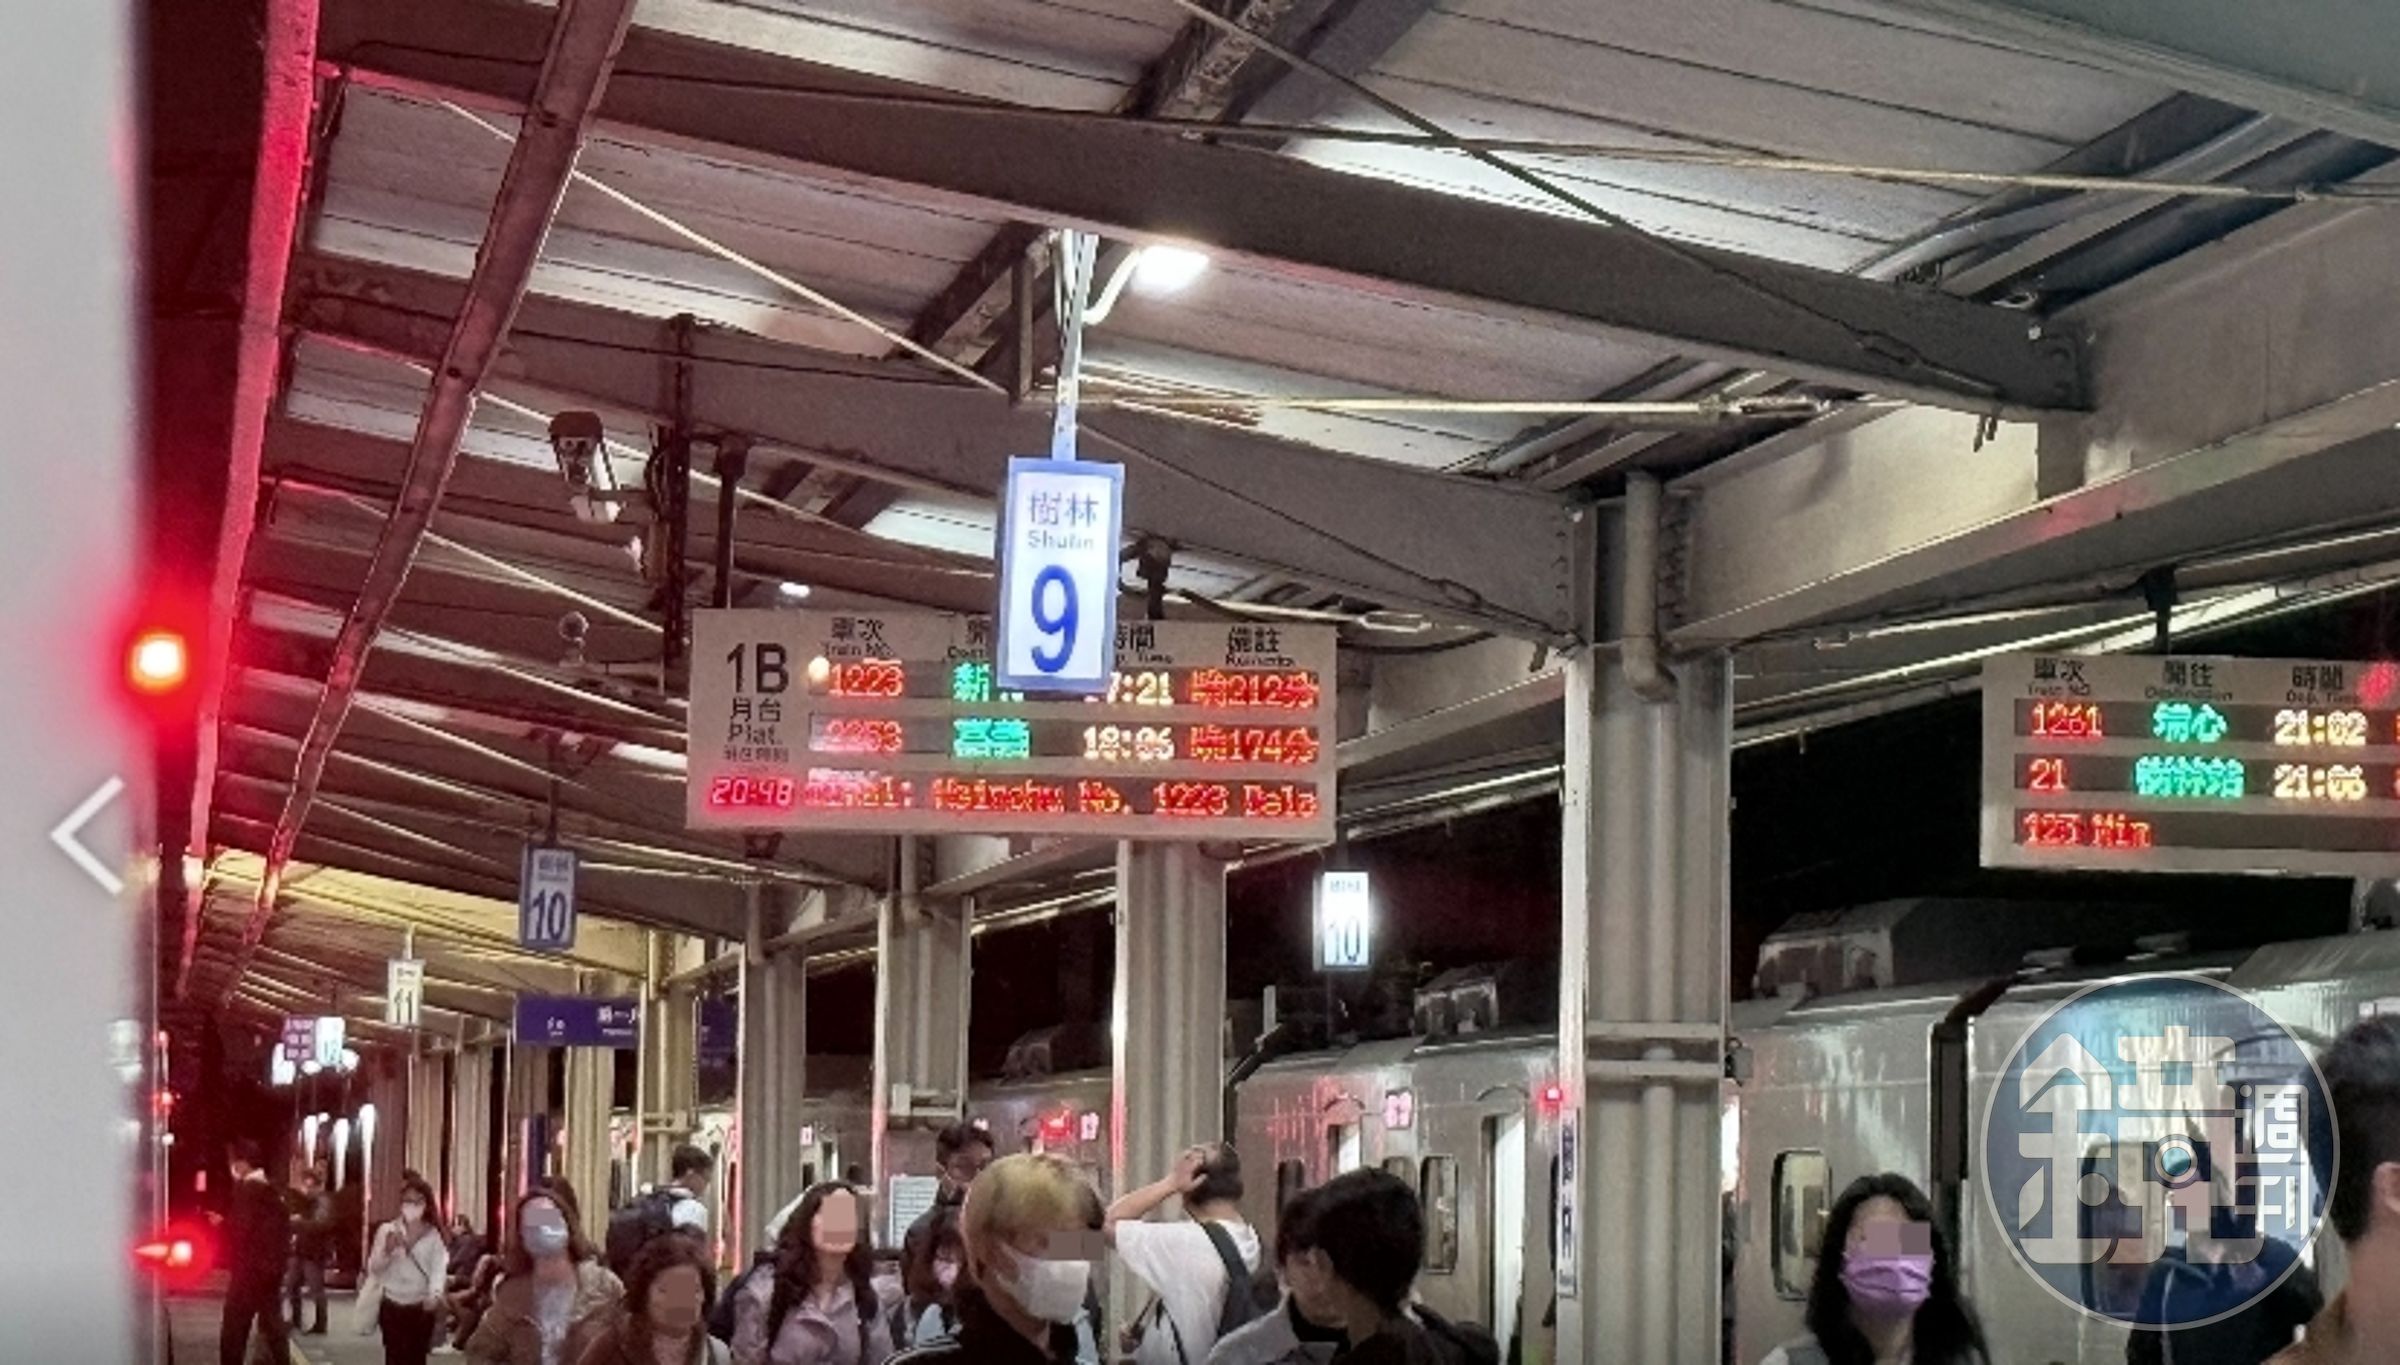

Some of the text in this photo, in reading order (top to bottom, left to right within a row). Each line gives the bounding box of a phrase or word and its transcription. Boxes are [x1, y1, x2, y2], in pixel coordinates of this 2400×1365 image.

[1028, 491, 1098, 527] 樹林
[1028, 529, 1094, 549] Shulin
[832, 617, 884, 641] 車次
[1031, 564, 1079, 673] 9
[727, 643, 788, 693] 1B
[829, 663, 904, 696] 1223
[1083, 671, 1175, 704] 7:21
[2292, 665, 2343, 690] 時間
[730, 697, 781, 722] 月台
[2032, 703, 2102, 737] 1261
[2274, 709, 2368, 747] 21:02
[728, 723, 783, 745] Plat.
[2029, 758, 2066, 790] 21
[712, 779, 794, 806] 20:48
[1153, 781, 1229, 815] 1223
[533, 888, 566, 940] 10
[394, 987, 414, 1025] 11
